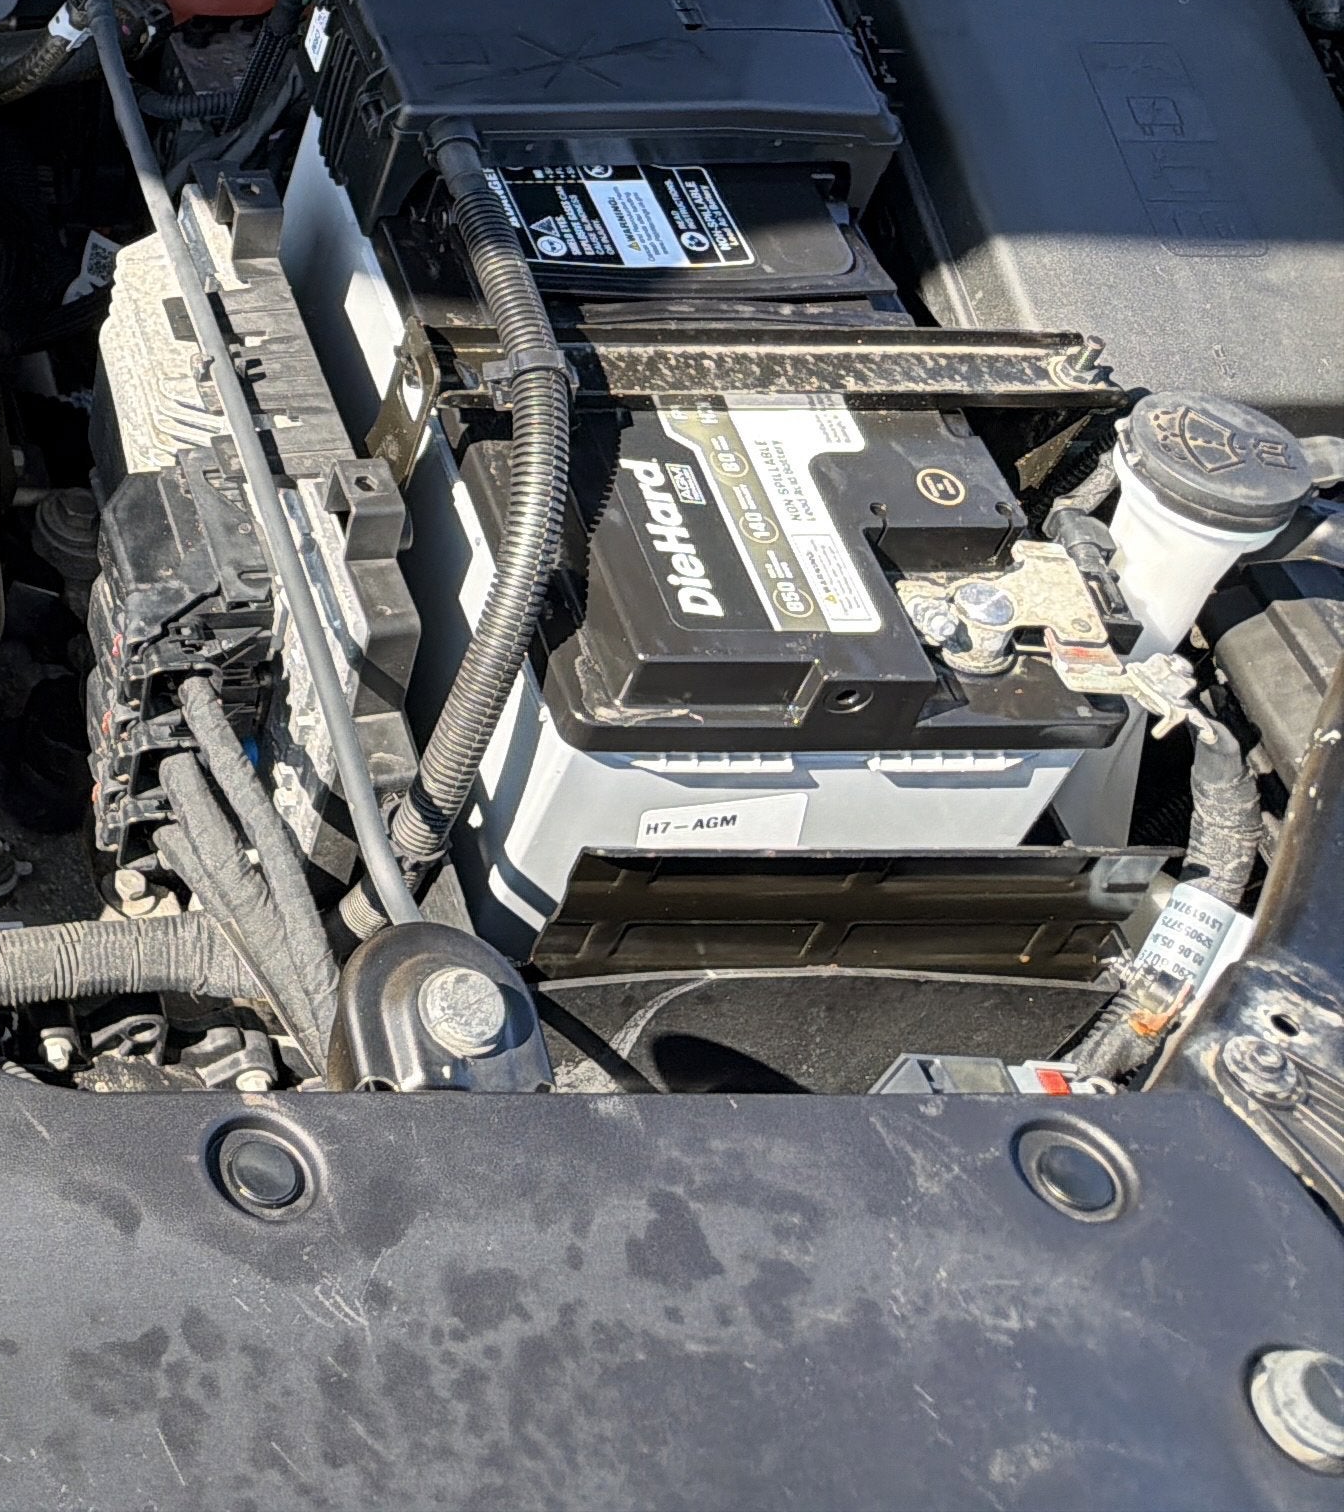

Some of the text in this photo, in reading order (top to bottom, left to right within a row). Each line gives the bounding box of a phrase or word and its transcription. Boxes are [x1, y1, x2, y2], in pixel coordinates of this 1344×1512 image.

[701, 185, 717, 209] Battery
[607, 197, 635, 242] WARNING:
[671, 210, 687, 230] READ
[685, 181, 732, 251] NON-SPILLABLE
[724, 228, 739, 246] Lead
[718, 453, 740, 472] 80
[669, 466, 694, 500] AGM
[619, 458, 724, 617] DieHard
[743, 512, 771, 539] 140
[776, 582, 805, 612] 850
